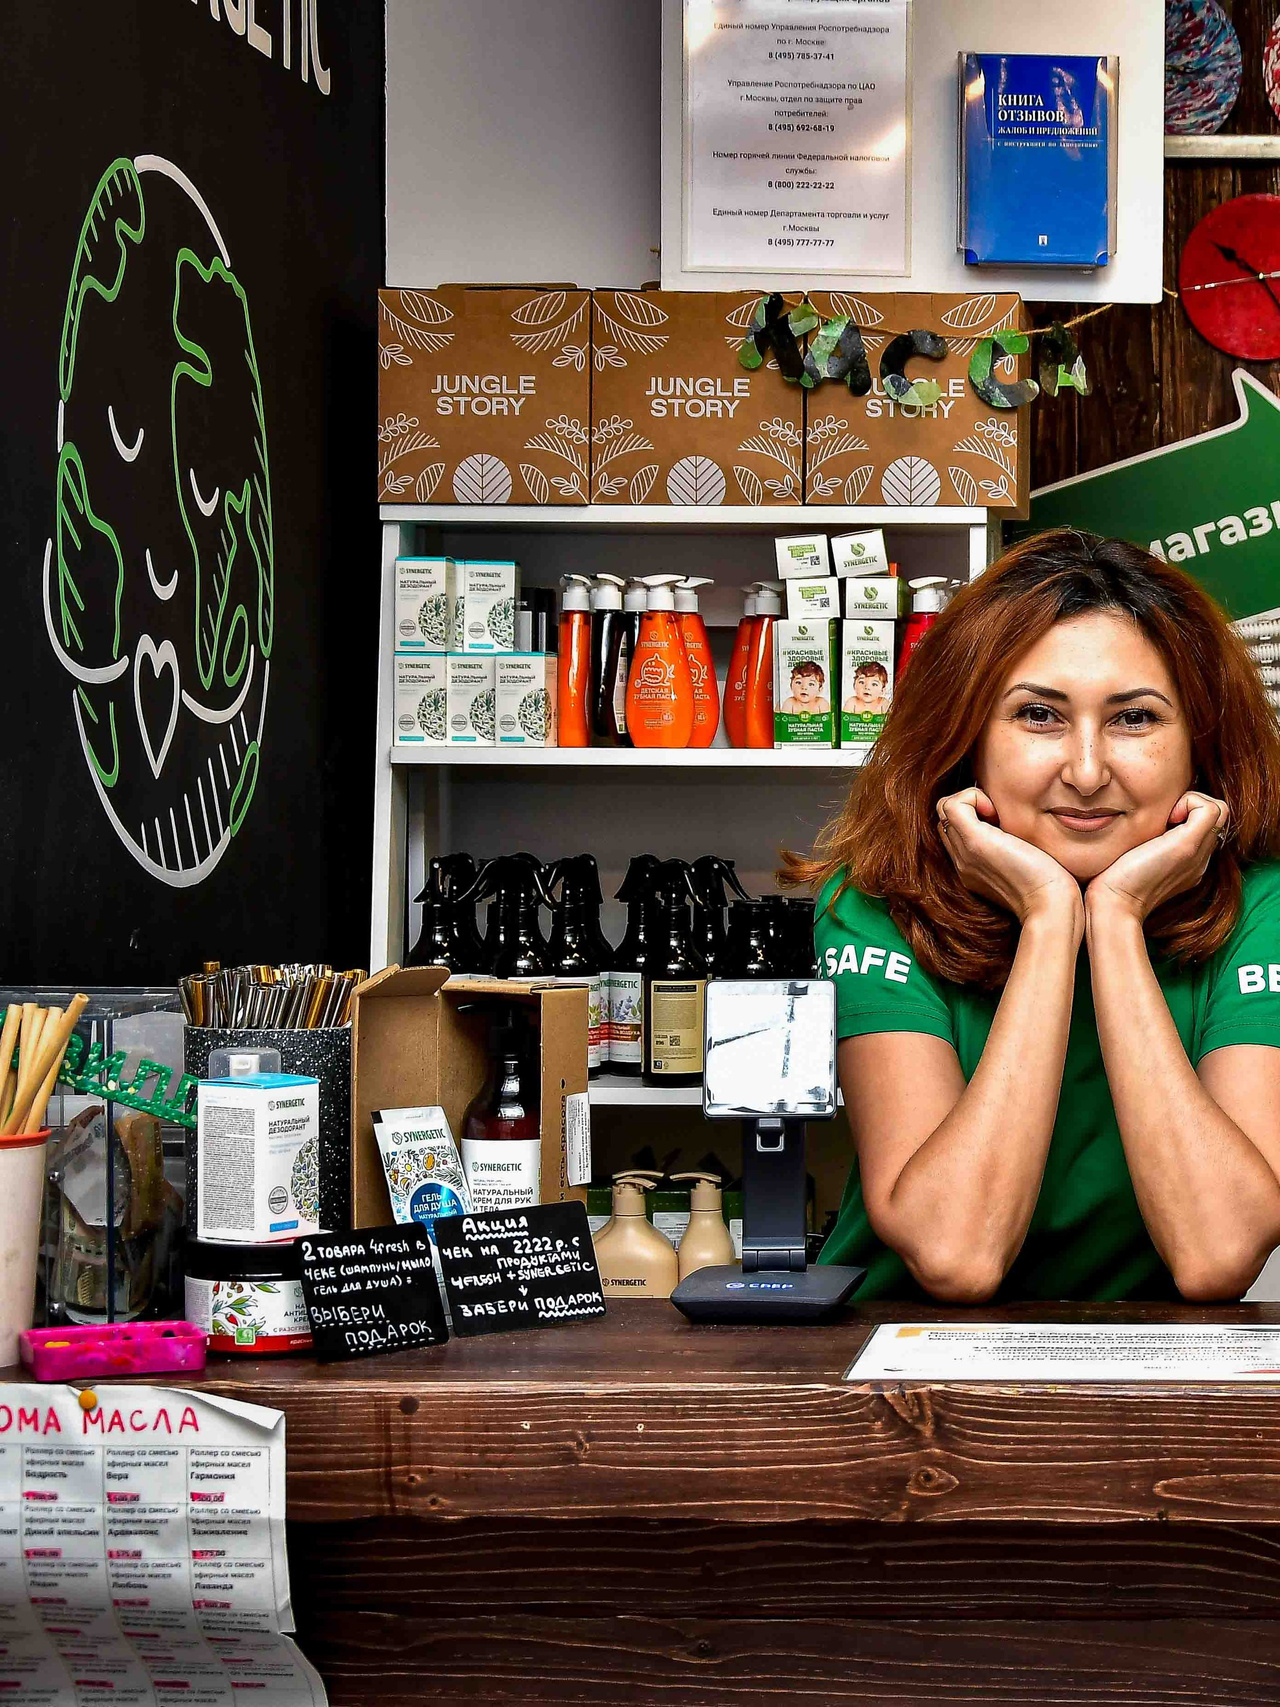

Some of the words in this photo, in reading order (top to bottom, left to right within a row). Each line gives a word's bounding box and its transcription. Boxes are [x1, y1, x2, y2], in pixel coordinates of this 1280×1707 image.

[998, 94, 1044, 106] КНИГА
[998, 110, 1067, 123] ОТЗЫВОВ,
[998, 126, 1028, 134] ЖАЛОБ
[1028, 126, 1035, 134] И
[1036, 126, 1098, 135] ПРЕДЛОЖЕНИЙ
[796, 181, 835, 190] 222-22-22
[712, 208, 743, 218] Единый
[744, 210, 769, 219] номер
[869, 213, 889, 222] услуг
[796, 239, 835, 247] 777-77-77
[431, 375, 535, 396] JUNGLE
[646, 377, 750, 398] JUNGLE
[436, 397, 524, 417] STORY
[651, 399, 740, 419] STORY
[865, 400, 955, 419] STORY
[854, 602, 888, 610] SYNERGETIC
[825, 944, 913, 984] SAFE
[276, 1098, 306, 1109] SYNERGETIC
[268, 1115, 310, 1127] НАТУРАЛЬНЫЙ
[268, 1123, 306, 1135] ДЕЗОДОРАНТ
[404, 1128, 446, 1144] SYNERGETIC
[480, 1163, 522, 1172] SYNERGETIC
[422, 1193, 443, 1202] ГЕЛЬ
[473, 1187, 533, 1196] НАТУРАЛЬНЫЙ
[413, 1204, 430, 1213] ДЛЯ
[431, 1200, 457, 1211] ДУША
[494, 1197, 512, 1205] ДЛЯ
[462, 1216, 528, 1234] Акция
[302, 1242, 316, 1261] 2
[317, 1245, 366, 1258] ТОВАРА
[443, 1246, 473, 1260] ЧЕК
[480, 1245, 499, 1256] НА
[497, 1250, 580, 1270] ПРОДУКТАМИ
[457, 1300, 529, 1317] ЗАБЕРИ
[535, 1291, 602, 1311] ПОДАРОК
[311, 1304, 385, 1324] ВЫБЕРИ
[345, 1320, 432, 1346] ПОДАРОК
[106, 1471, 129, 1480] Вера
[190, 1472, 236, 1481] Гармония
